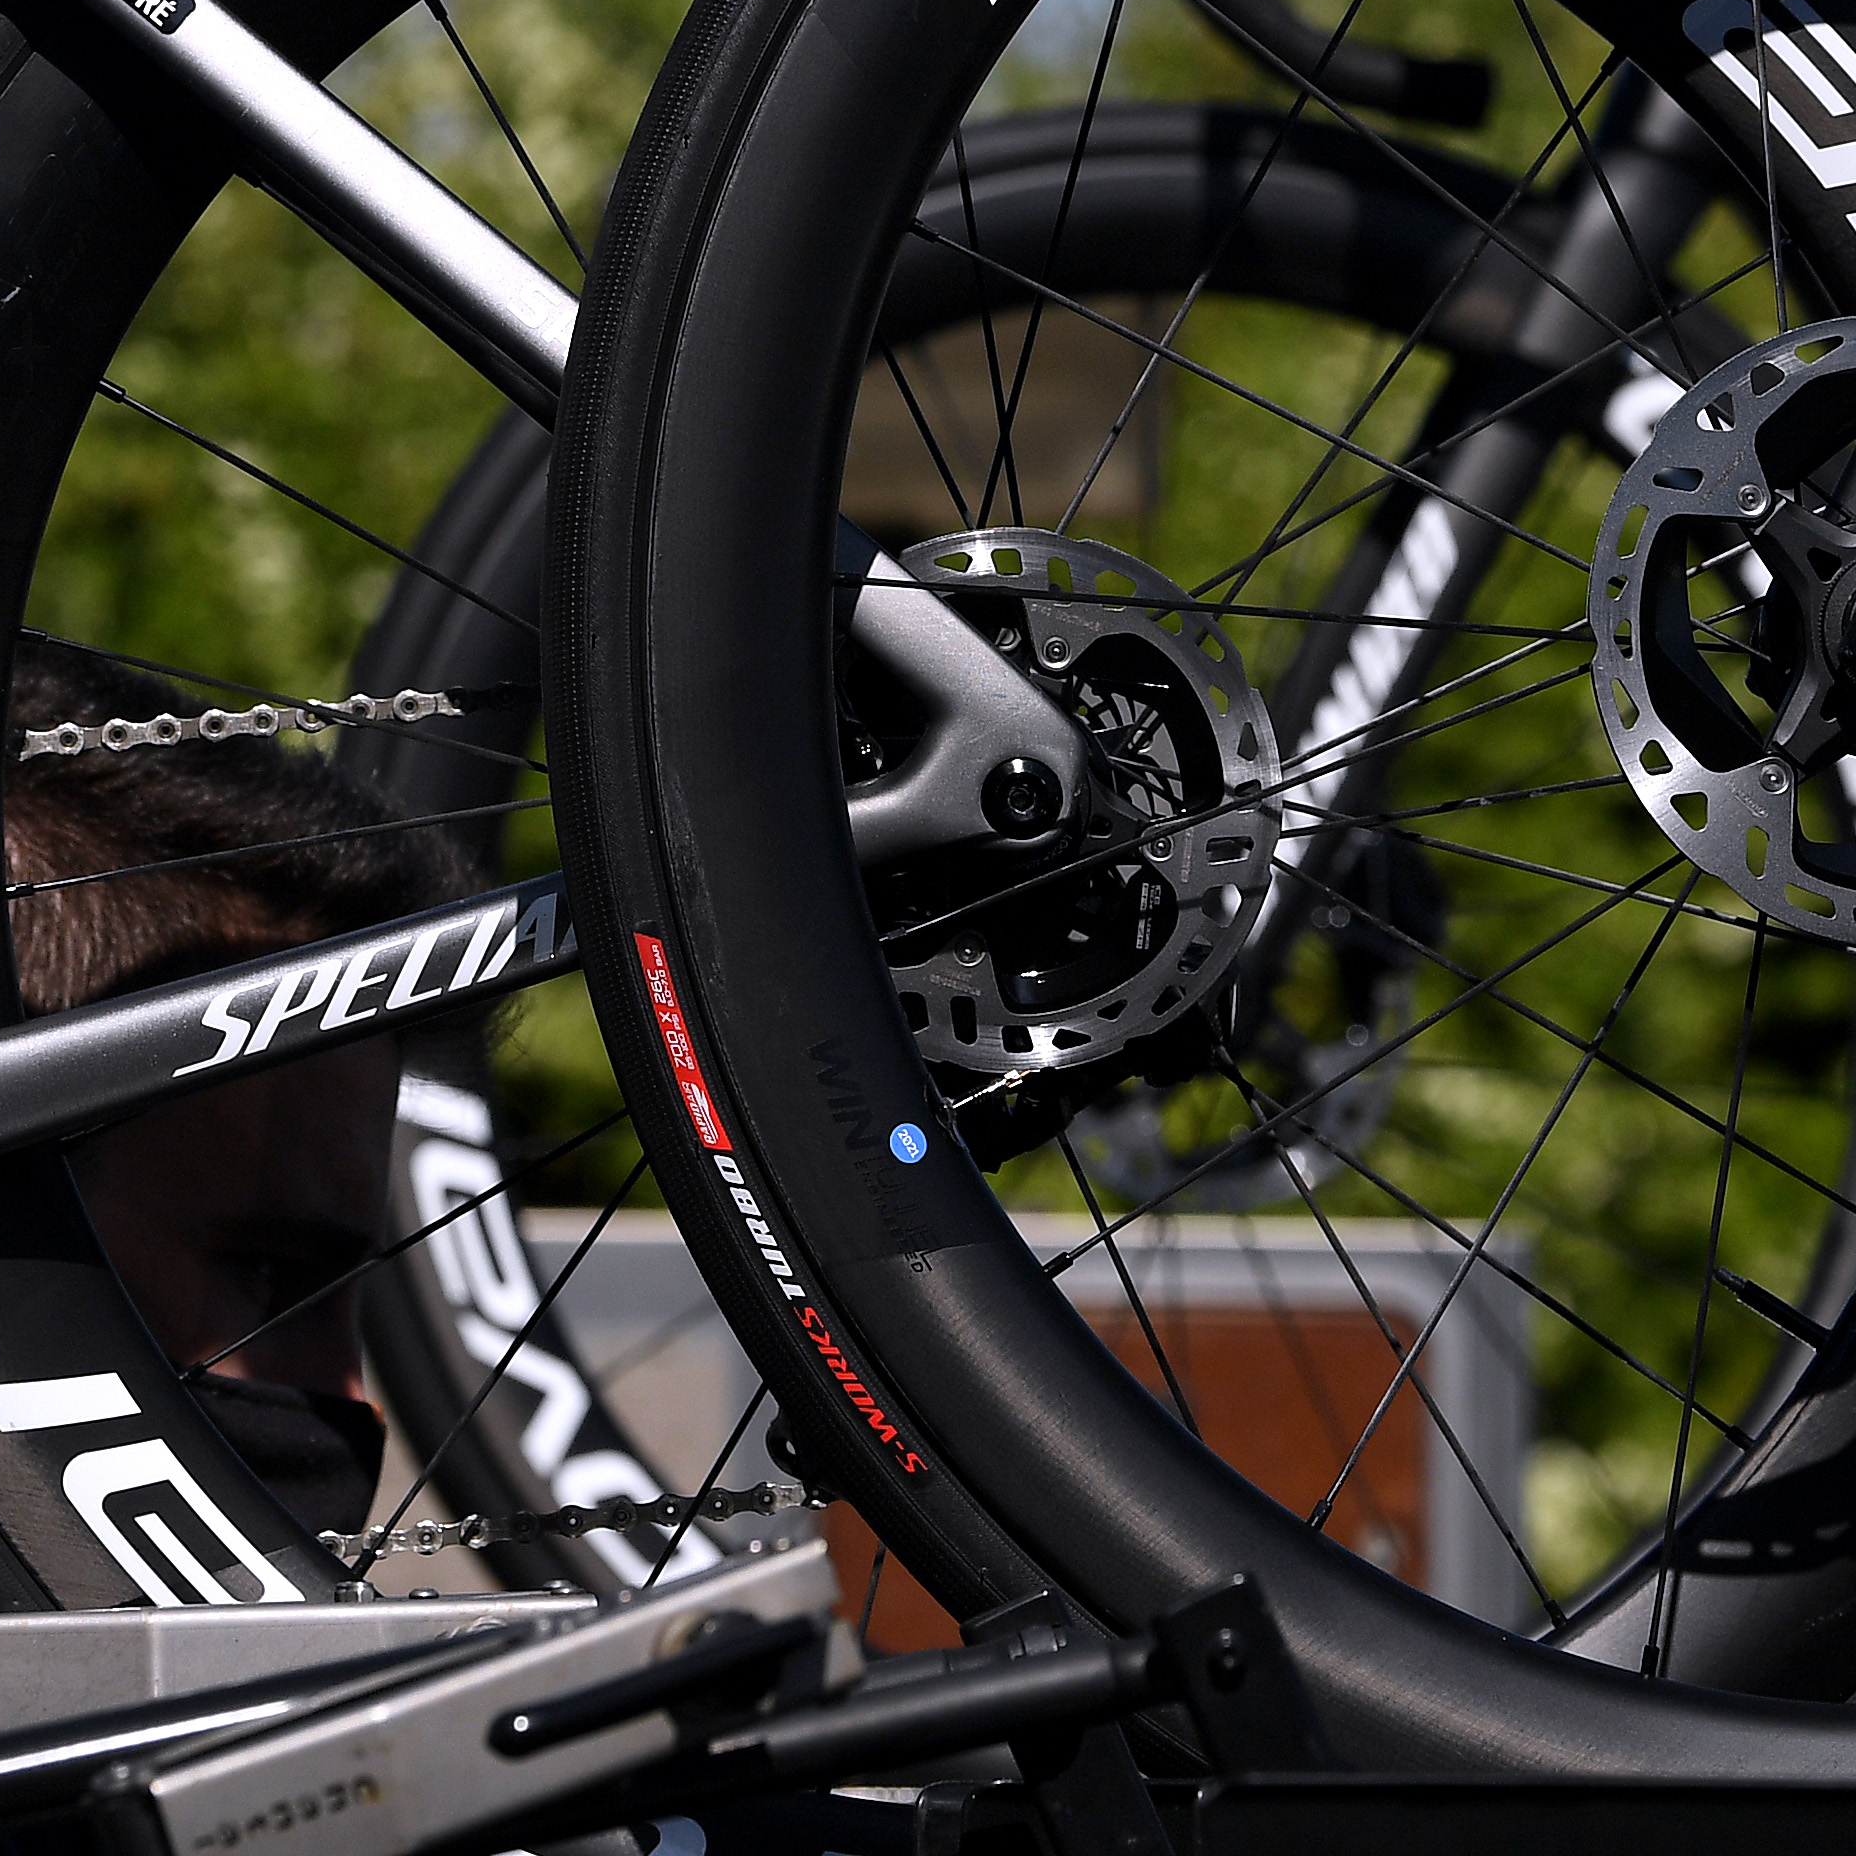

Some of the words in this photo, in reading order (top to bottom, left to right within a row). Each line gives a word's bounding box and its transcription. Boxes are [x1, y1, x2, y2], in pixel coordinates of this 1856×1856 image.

[172, 892, 580, 1079] SPECIA
[647, 969, 667, 1005] 26C
[666, 1030, 687, 1069] 700
[807, 1040, 873, 1150] WIN
[896, 1128, 921, 1159] 2021
[714, 1154, 805, 1301] TURBO
[394, 1074, 730, 1588] oval
[793, 1306, 928, 1473] S-WORKS
